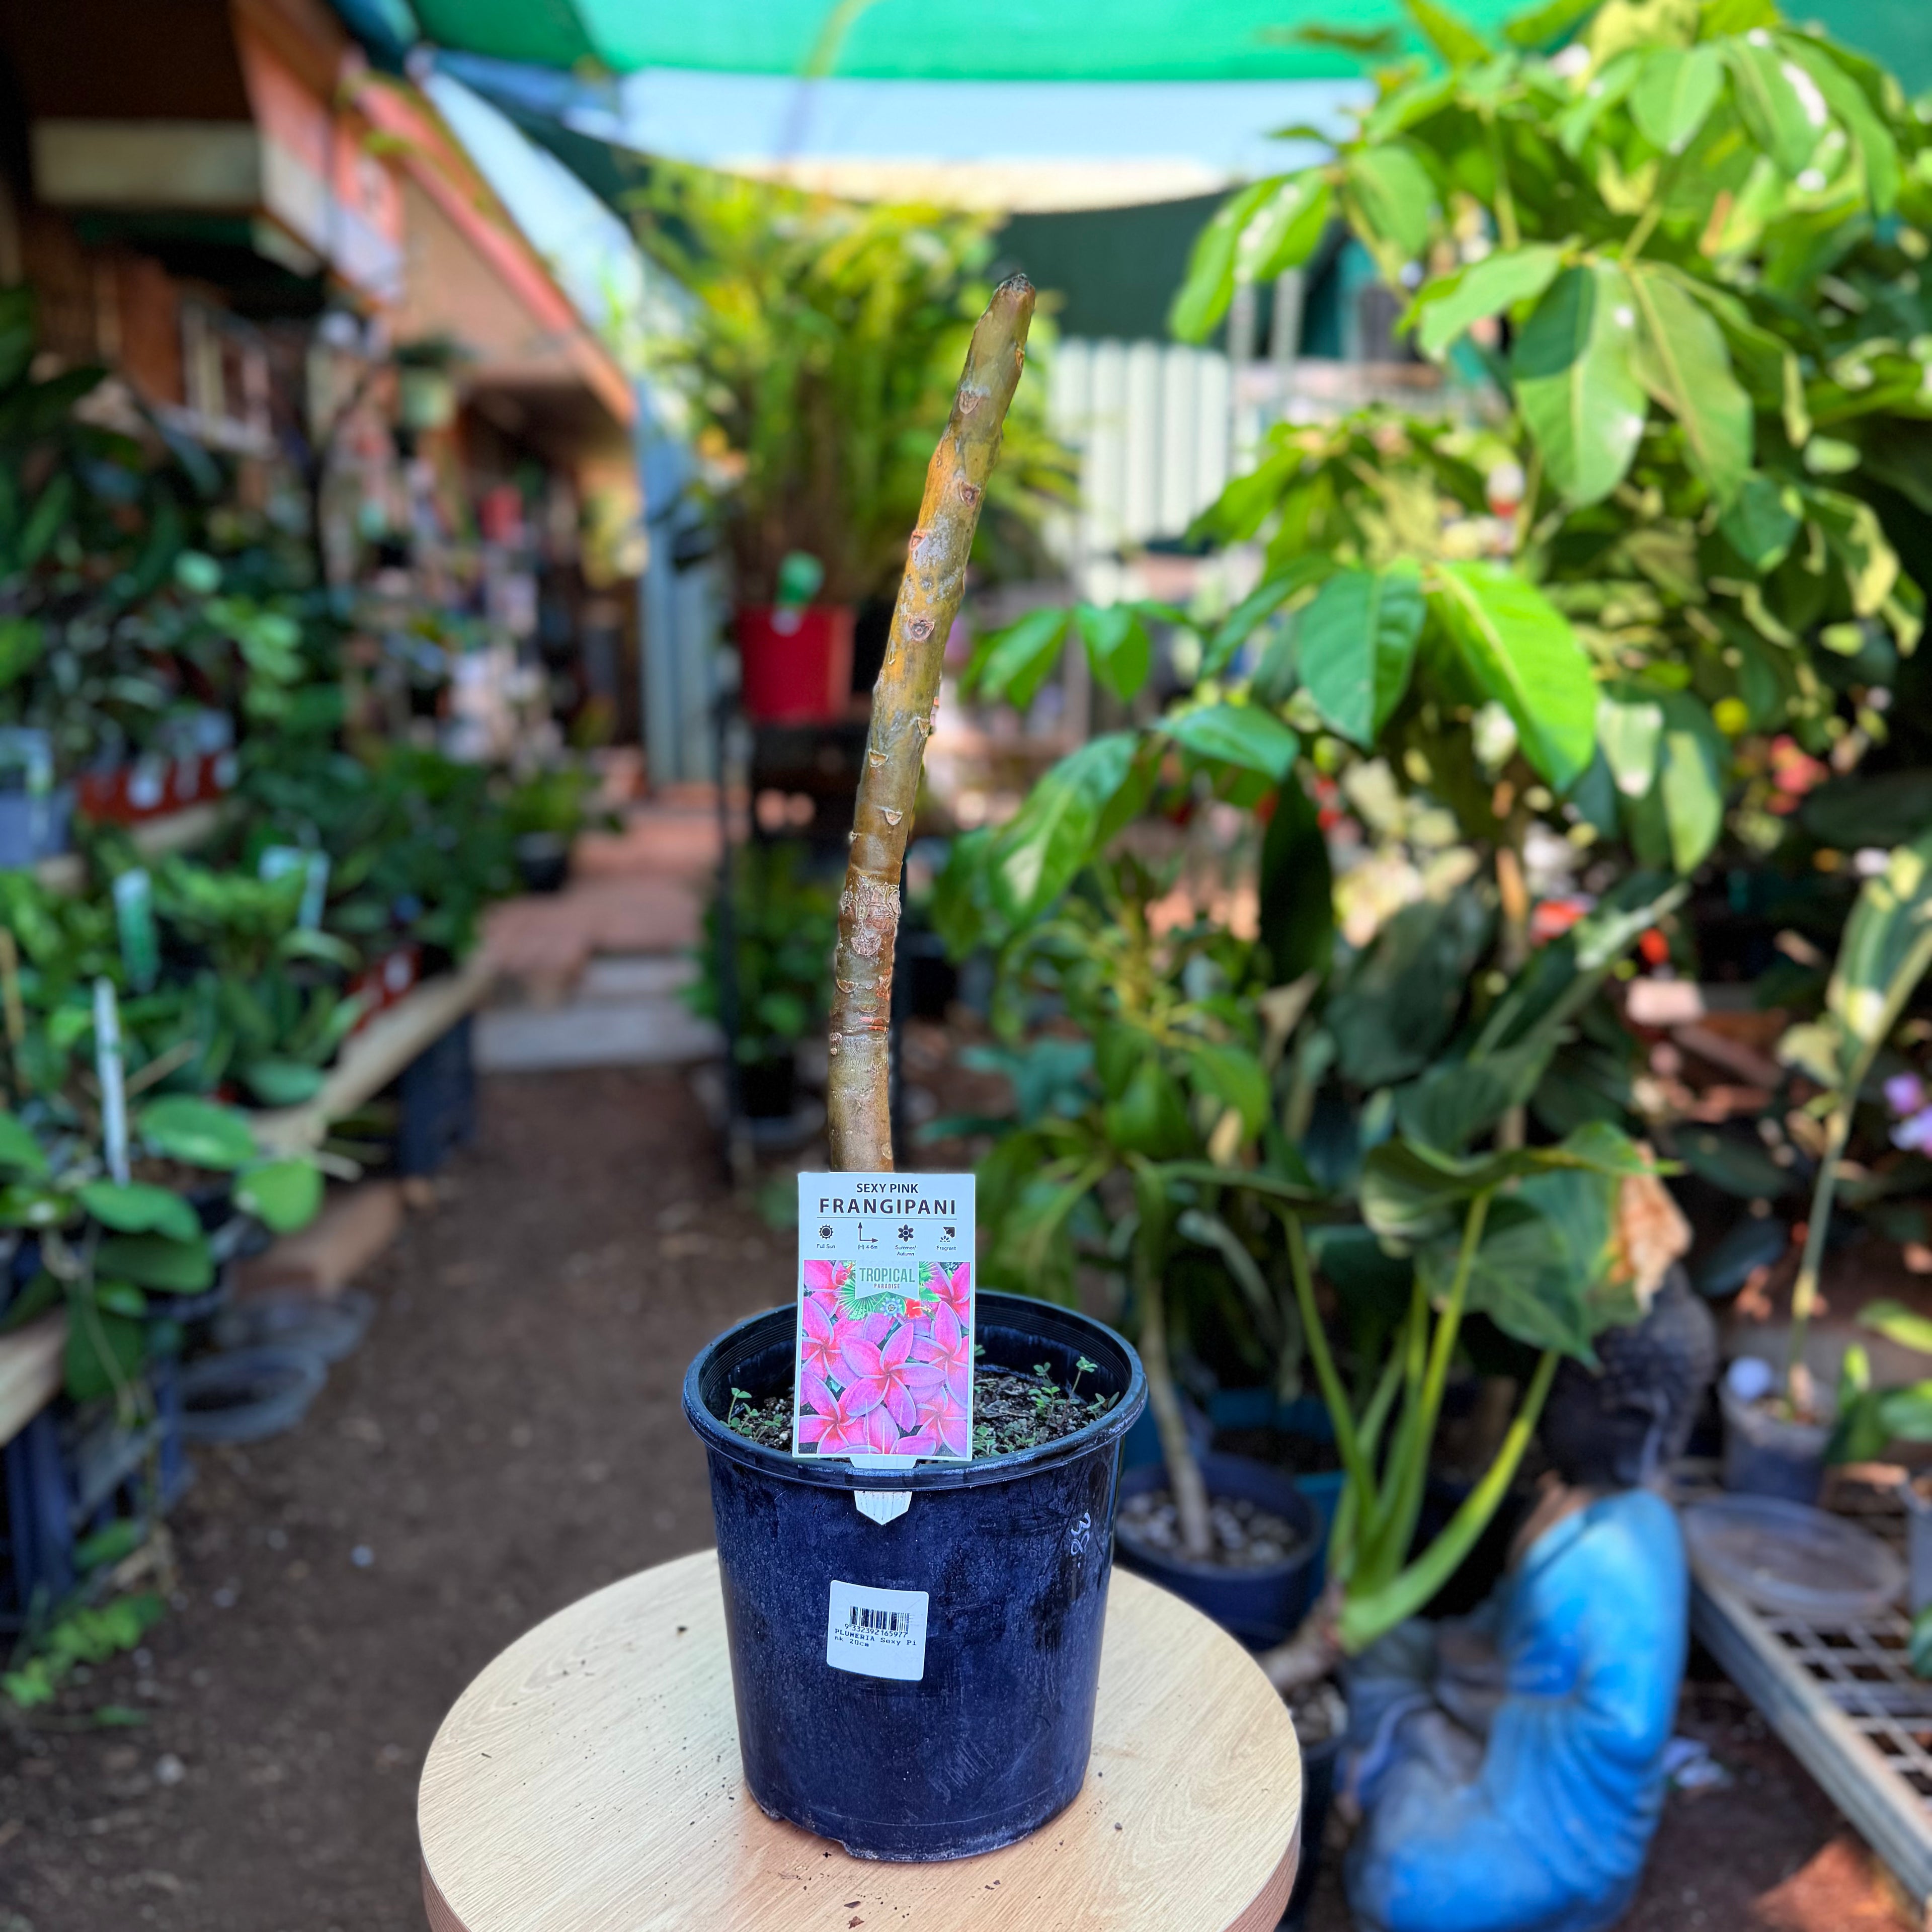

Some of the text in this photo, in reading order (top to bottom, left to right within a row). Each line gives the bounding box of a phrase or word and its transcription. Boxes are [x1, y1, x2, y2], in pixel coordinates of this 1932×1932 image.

[856, 1183, 918, 1193] SEXY PINK
[819, 1198, 955, 1215] FRANGIPANI
[859, 1267, 915, 1283] TROPICAL
[835, 1628, 875, 1642] PLUMERIA
[880, 1638, 901, 1646] Sexy
[849, 1639, 869, 1648] 20cm
